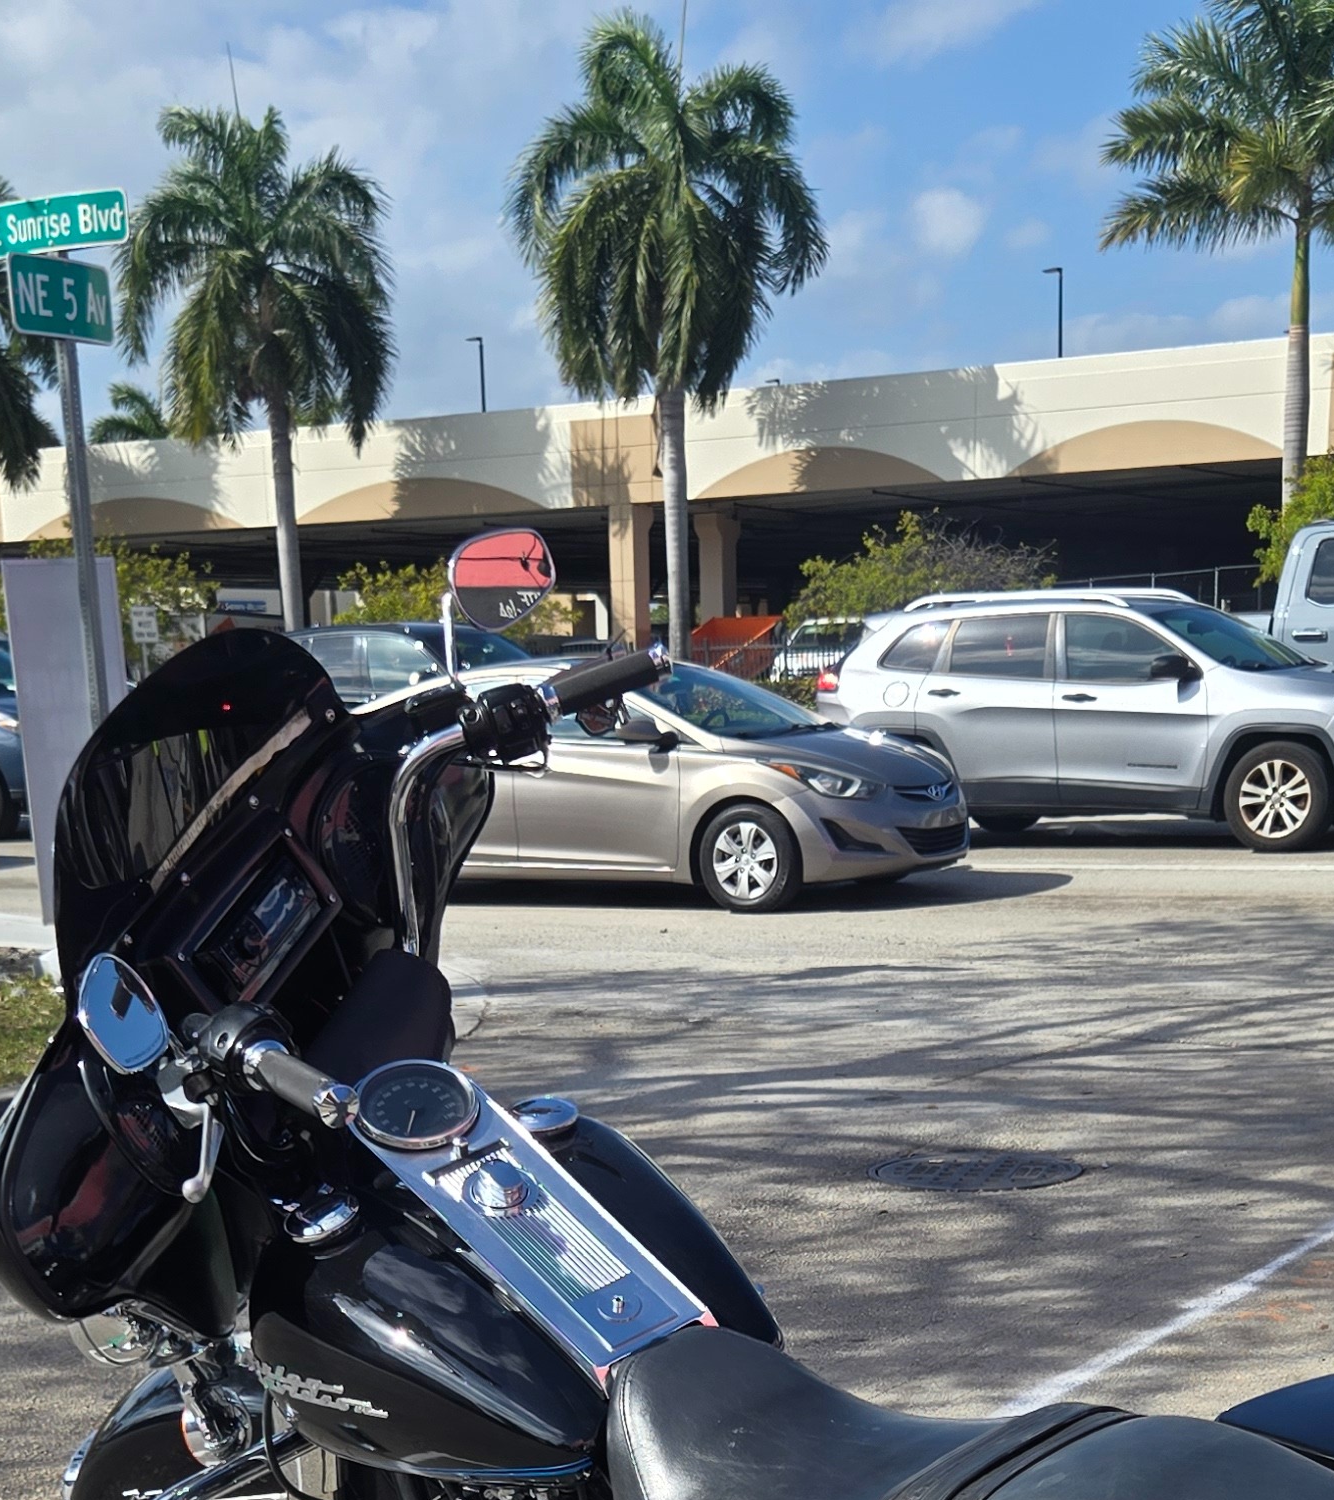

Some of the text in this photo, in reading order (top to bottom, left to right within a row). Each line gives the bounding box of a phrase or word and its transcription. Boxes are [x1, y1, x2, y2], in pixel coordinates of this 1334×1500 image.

[7, 209, 71, 245] Sunrise
[78, 203, 123, 235] Blvd
[17, 272, 53, 318] NE
[62, 278, 78, 322] 5
